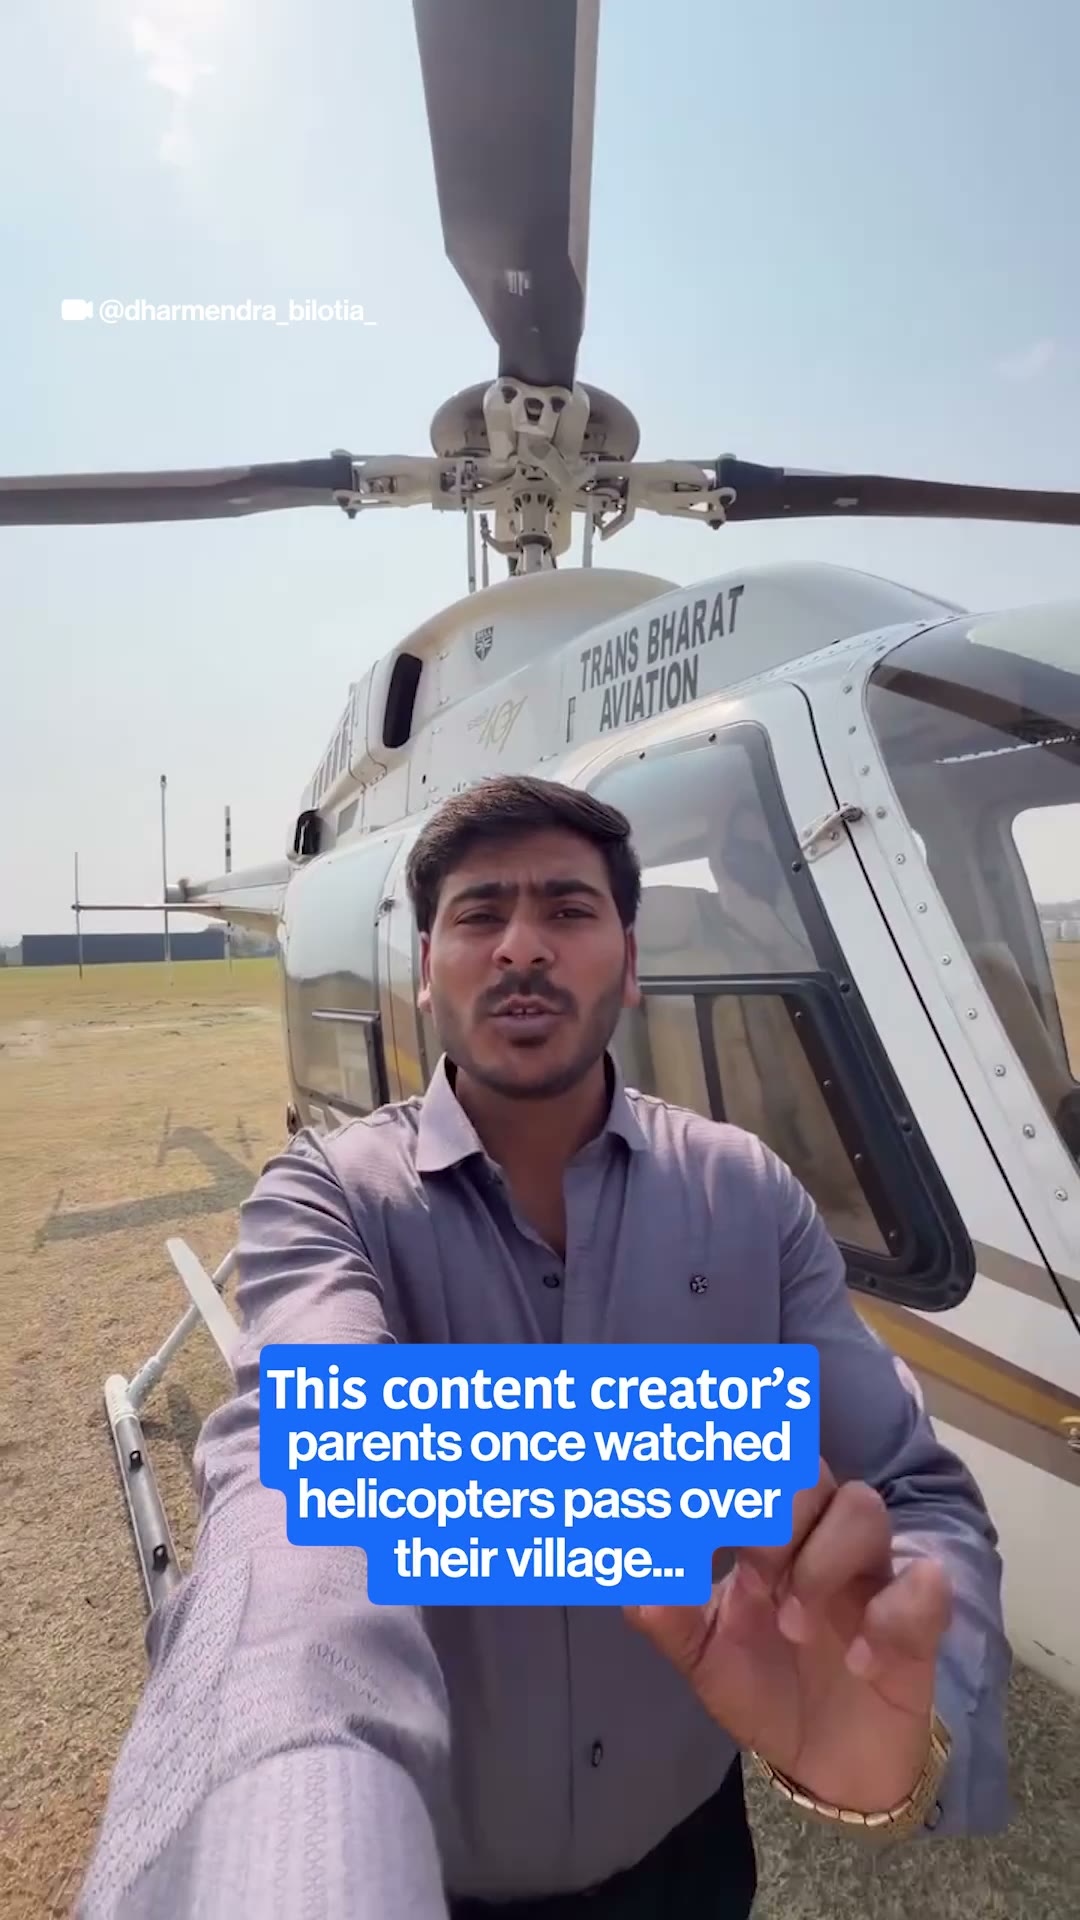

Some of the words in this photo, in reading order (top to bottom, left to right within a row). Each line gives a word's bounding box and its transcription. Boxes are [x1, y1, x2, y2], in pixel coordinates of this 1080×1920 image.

[580, 626, 639, 692] TRANS
[647, 585, 744, 665] BHARAT
[600, 654, 699, 732] AVIATION
